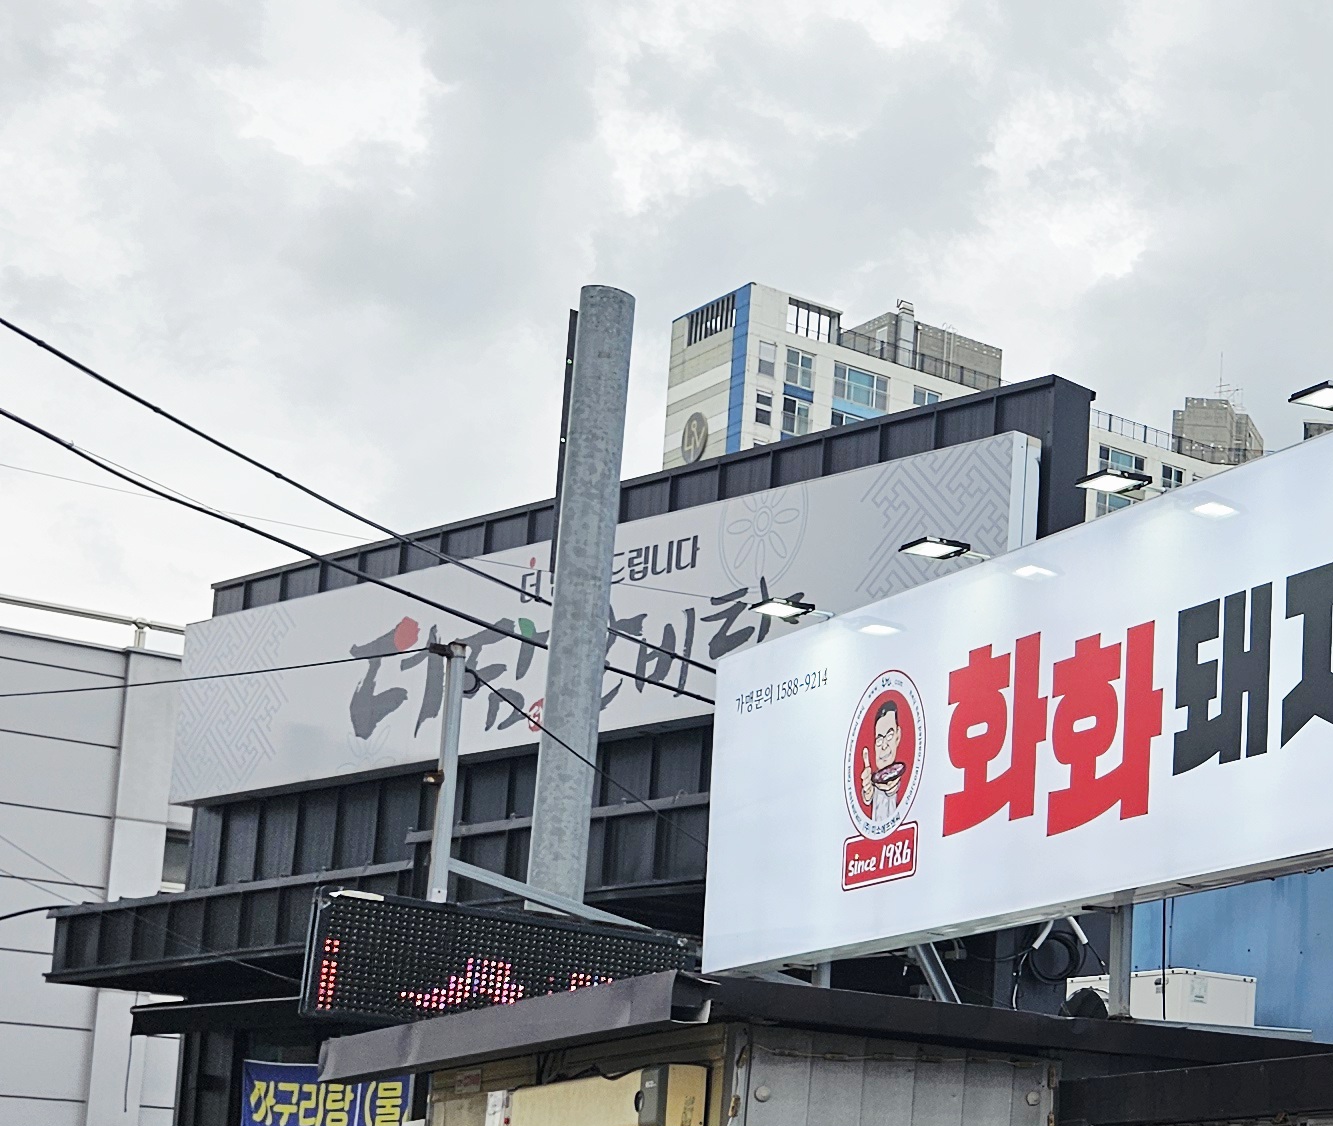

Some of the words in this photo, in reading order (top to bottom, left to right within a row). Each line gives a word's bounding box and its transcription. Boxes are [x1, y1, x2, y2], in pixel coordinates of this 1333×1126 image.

[736, 683, 774, 715] 가맹문의
[776, 668, 828, 703] 1588-9214
[848, 853, 877, 877] since
[880, 840, 911, 869] 1986
